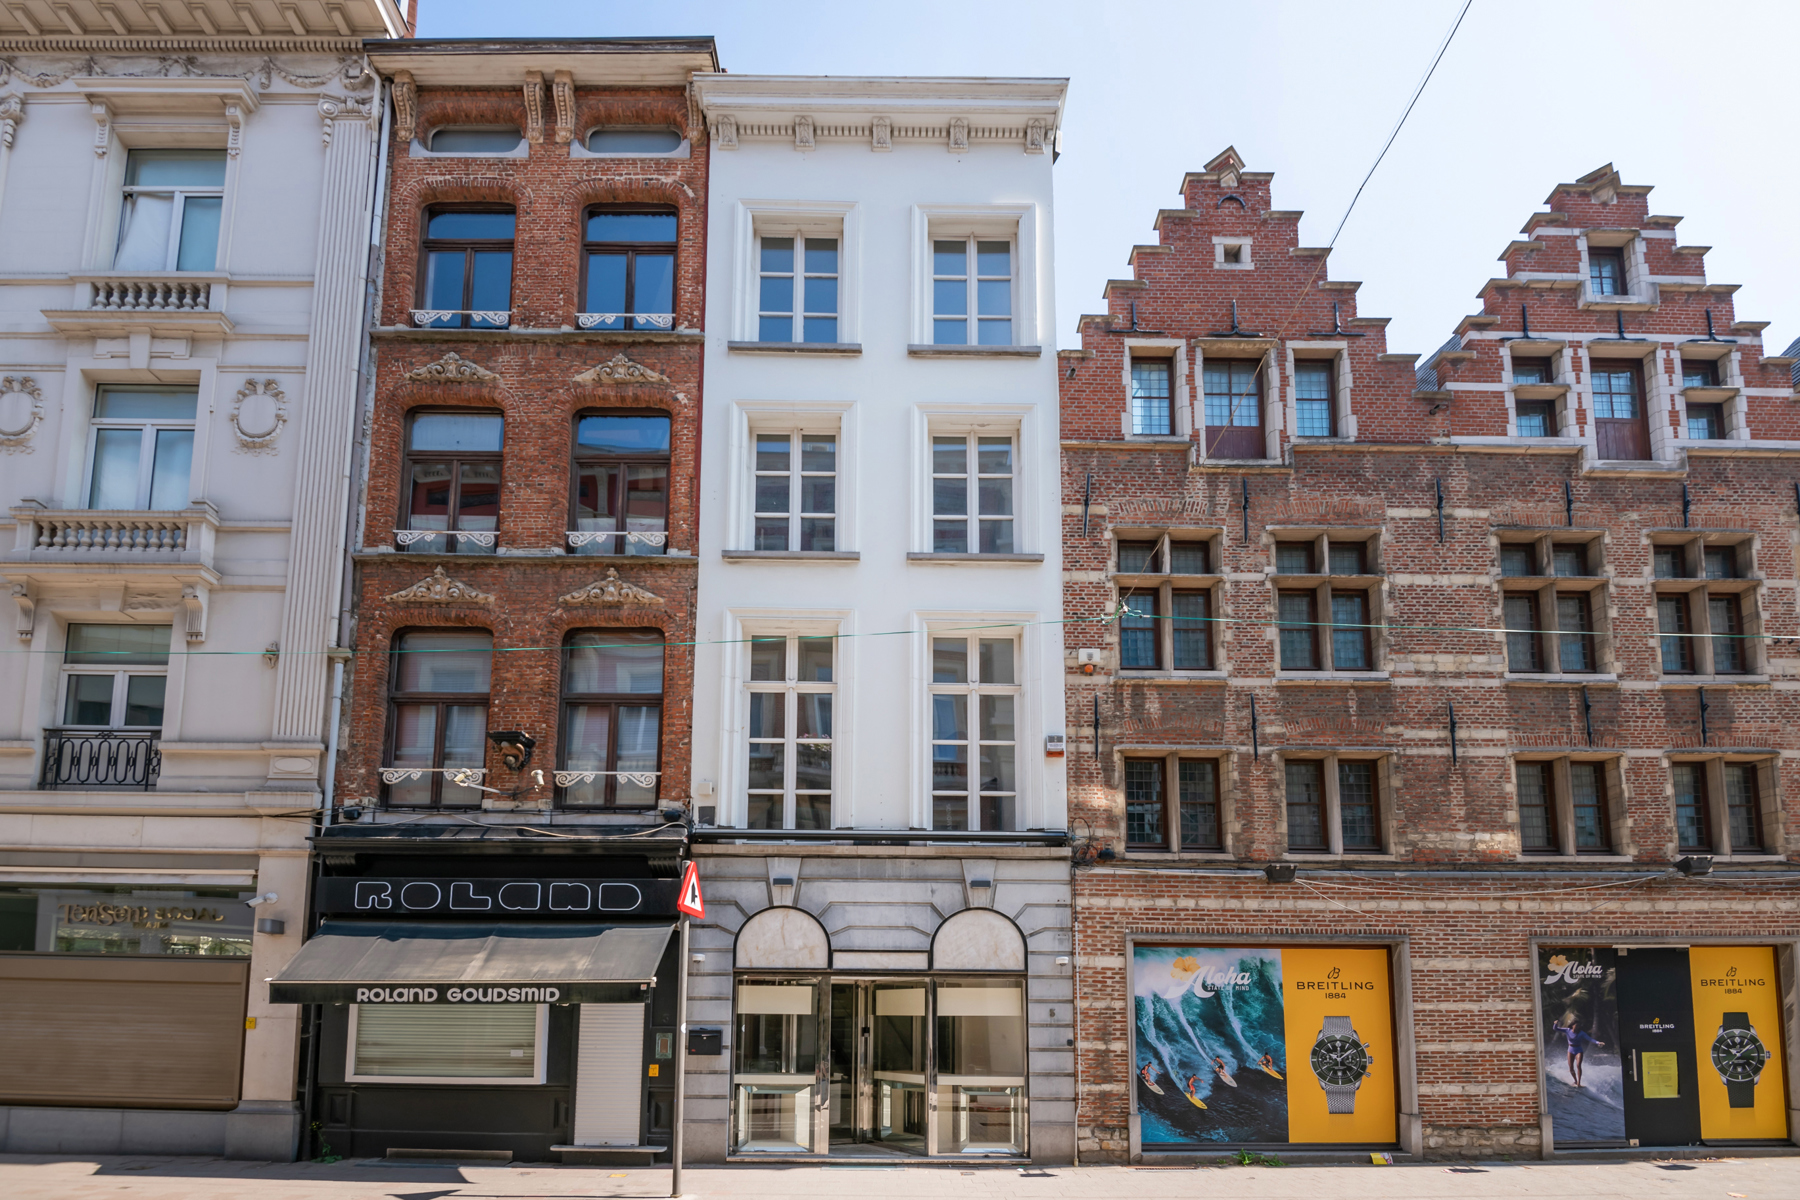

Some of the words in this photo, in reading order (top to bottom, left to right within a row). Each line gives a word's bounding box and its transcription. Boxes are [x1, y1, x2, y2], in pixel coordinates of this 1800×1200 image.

[354, 881, 642, 911] ROLAND
[58, 903, 141, 926] TenSen
[1164, 965, 1252, 999] Aloha
[1544, 961, 1603, 984] Aloha
[1700, 979, 1766, 987] BREITLING
[356, 987, 438, 1003] ROLAND
[446, 987, 560, 1003] GOUDSMID
[1296, 981, 1374, 990] BREITLING
